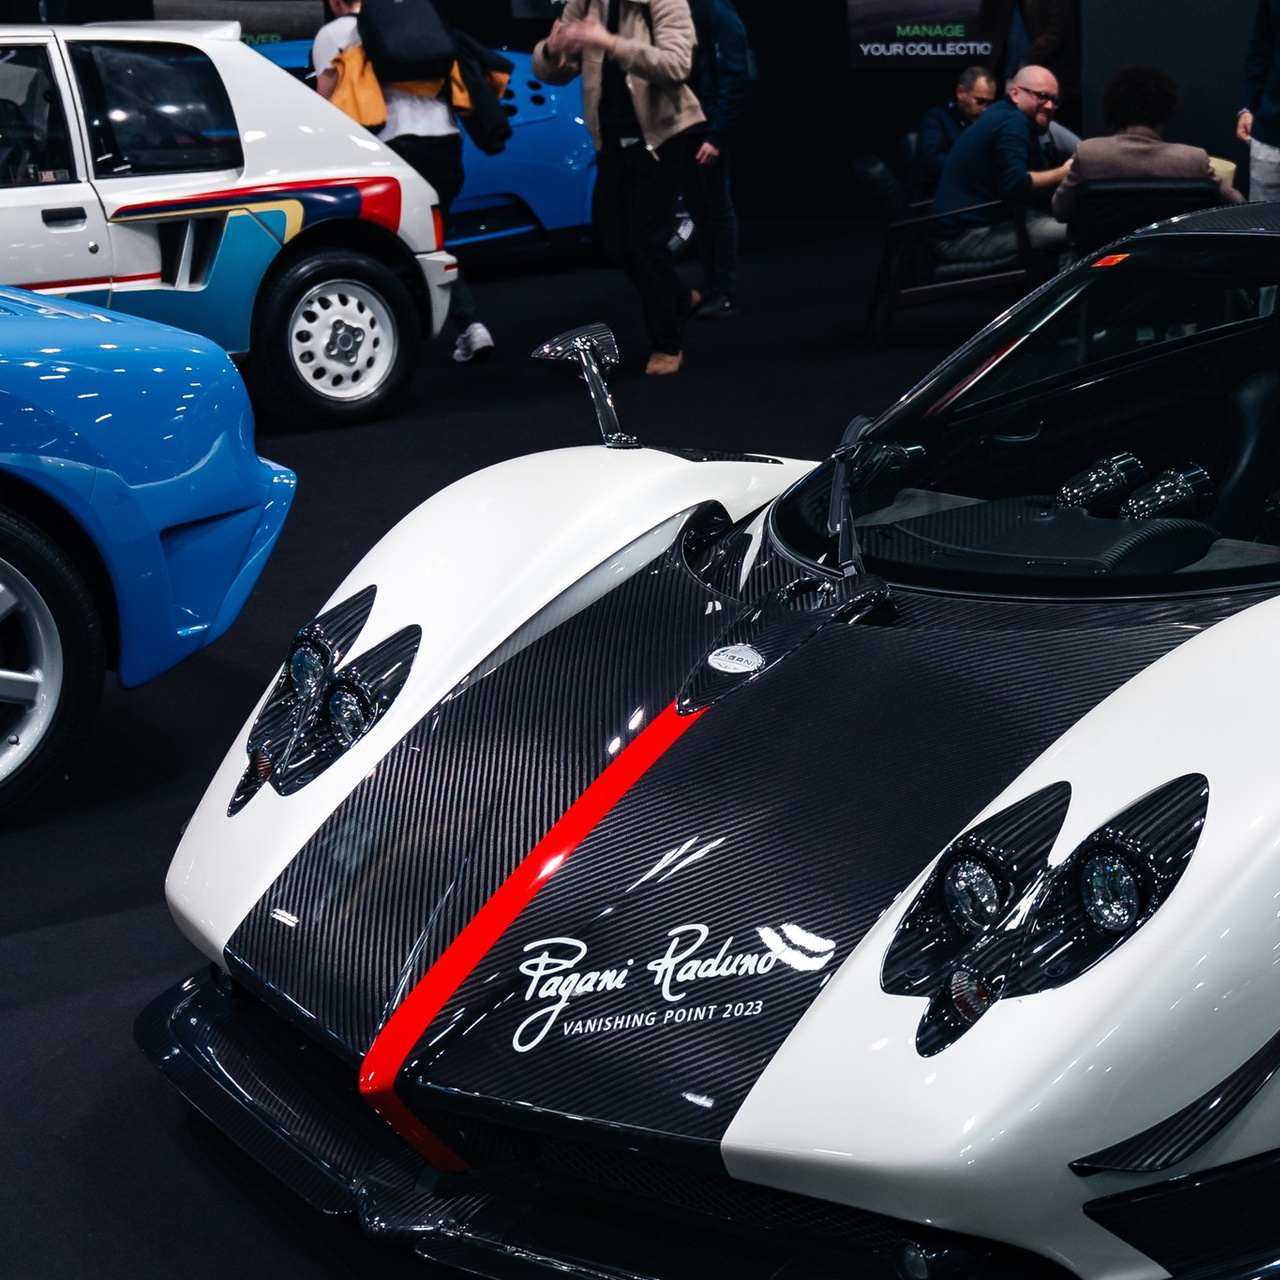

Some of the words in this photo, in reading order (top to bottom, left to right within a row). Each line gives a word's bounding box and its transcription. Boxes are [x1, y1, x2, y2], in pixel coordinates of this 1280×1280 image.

[896, 24, 965, 38] MANAGE
[860, 42, 904, 56] YOUR
[905, 42, 992, 56] COLLECTIO
[512, 936, 635, 1053] Pagani
[646, 922, 777, 1002] Raduno
[562, 1010, 657, 1036] VANISHING
[663, 1005, 717, 1025] POINT
[723, 1000, 764, 1018] 2023
